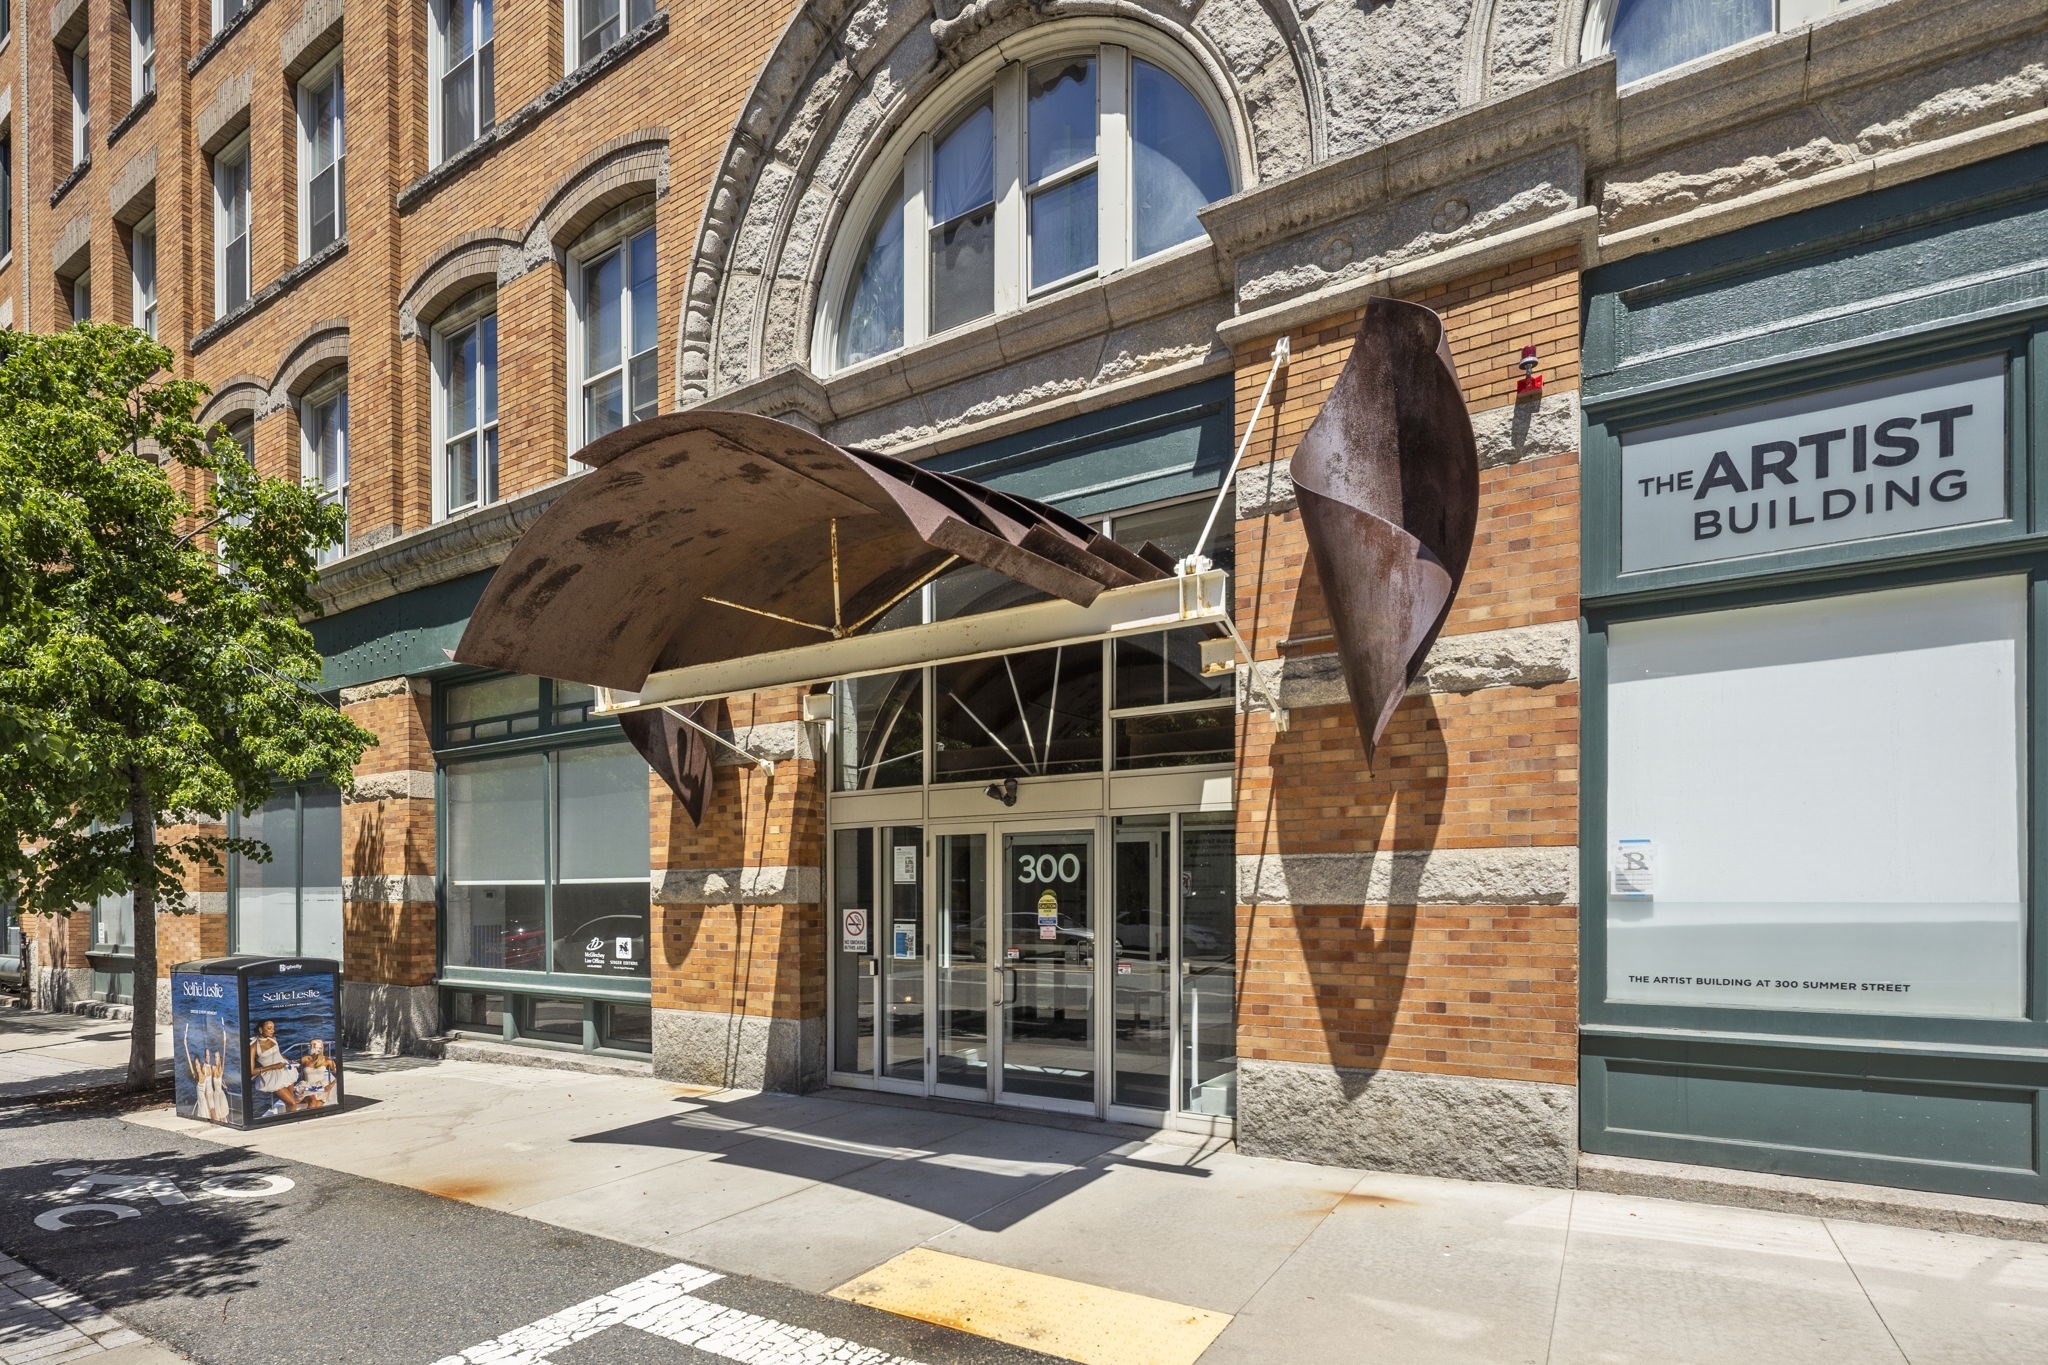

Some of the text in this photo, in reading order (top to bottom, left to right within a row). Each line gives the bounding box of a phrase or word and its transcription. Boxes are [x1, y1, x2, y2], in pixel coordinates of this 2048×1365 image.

[1638, 404, 1974, 501] THE ARTIST
[1693, 469, 1968, 541] BUILDING
[1018, 853, 1080, 884] 300
[183, 981, 224, 998] Selfie Leslie
[262, 989, 320, 1002] Selfie Leslie
[1628, 975, 1911, 993] THE ARTIST BUILDING AT 300 SUMMER STREET
